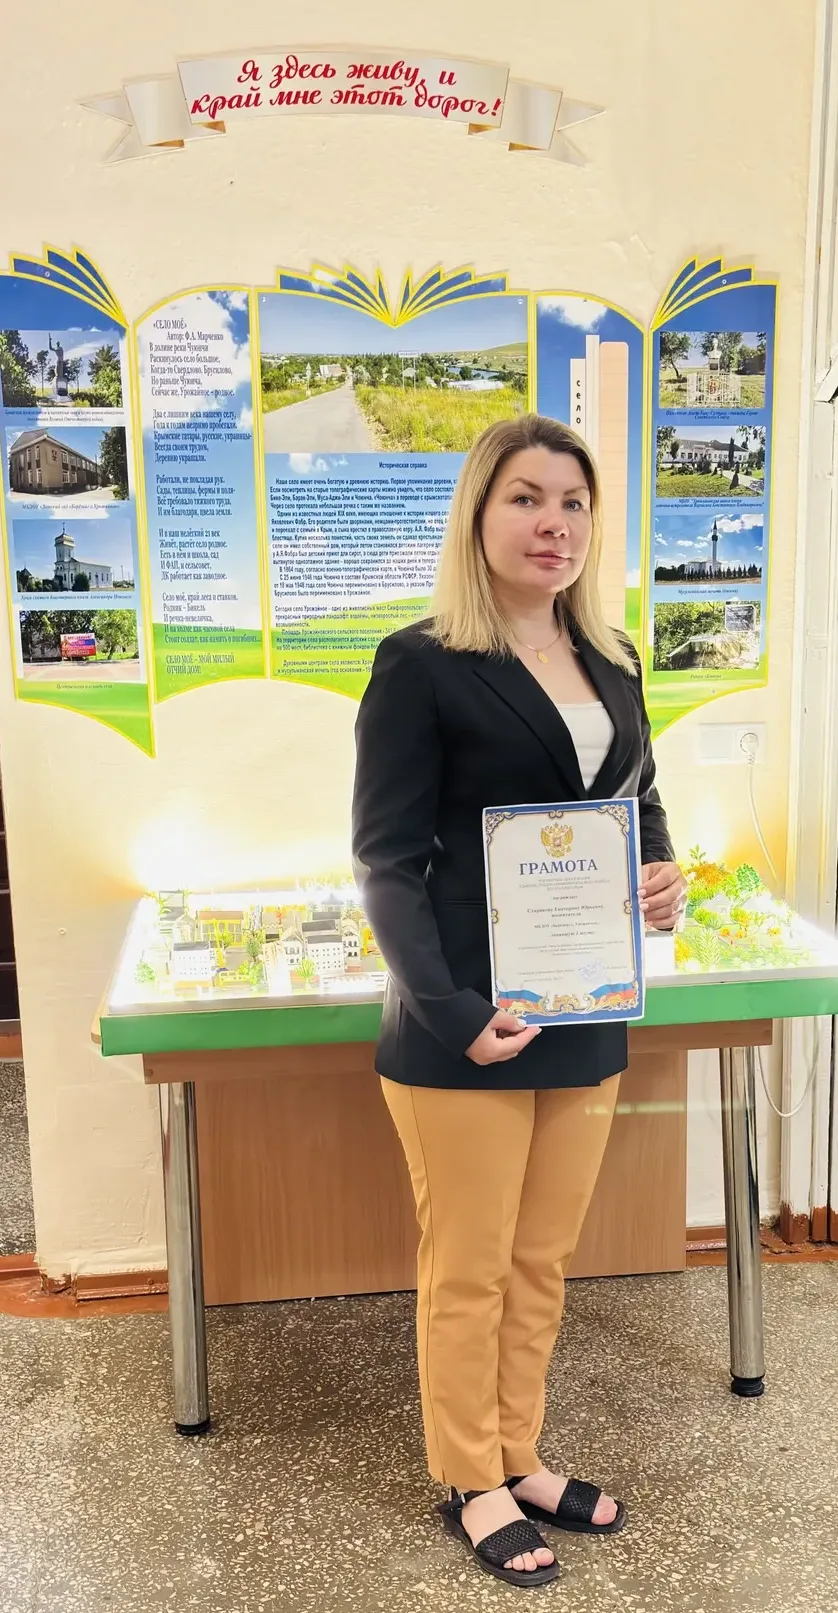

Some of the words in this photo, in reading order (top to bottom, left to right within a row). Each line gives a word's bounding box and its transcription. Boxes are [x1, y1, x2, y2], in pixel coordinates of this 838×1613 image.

[237, 60, 262, 83] Я
[269, 54, 336, 88] здесь
[346, 60, 426, 88] живу,
[438, 70, 457, 86] и
[190, 86, 262, 120] край
[270, 90, 322, 106] мне
[330, 84, 406, 106] этот
[414, 81, 502, 118] дорог!
[167, 333, 184, 344] Автор:
[185, 332, 196, 341] Ф.А.
[198, 333, 224, 343] Марченко
[150, 342, 154, 352] В
[174, 345, 186, 354] реки
[150, 354, 184, 364] Раскинулось
[196, 354, 220, 363] большое,
[158, 507, 162, 516] И
[158, 528, 164, 538] И
[160, 560, 166, 570] И
[519, 859, 598, 876] ГРАМОТА
